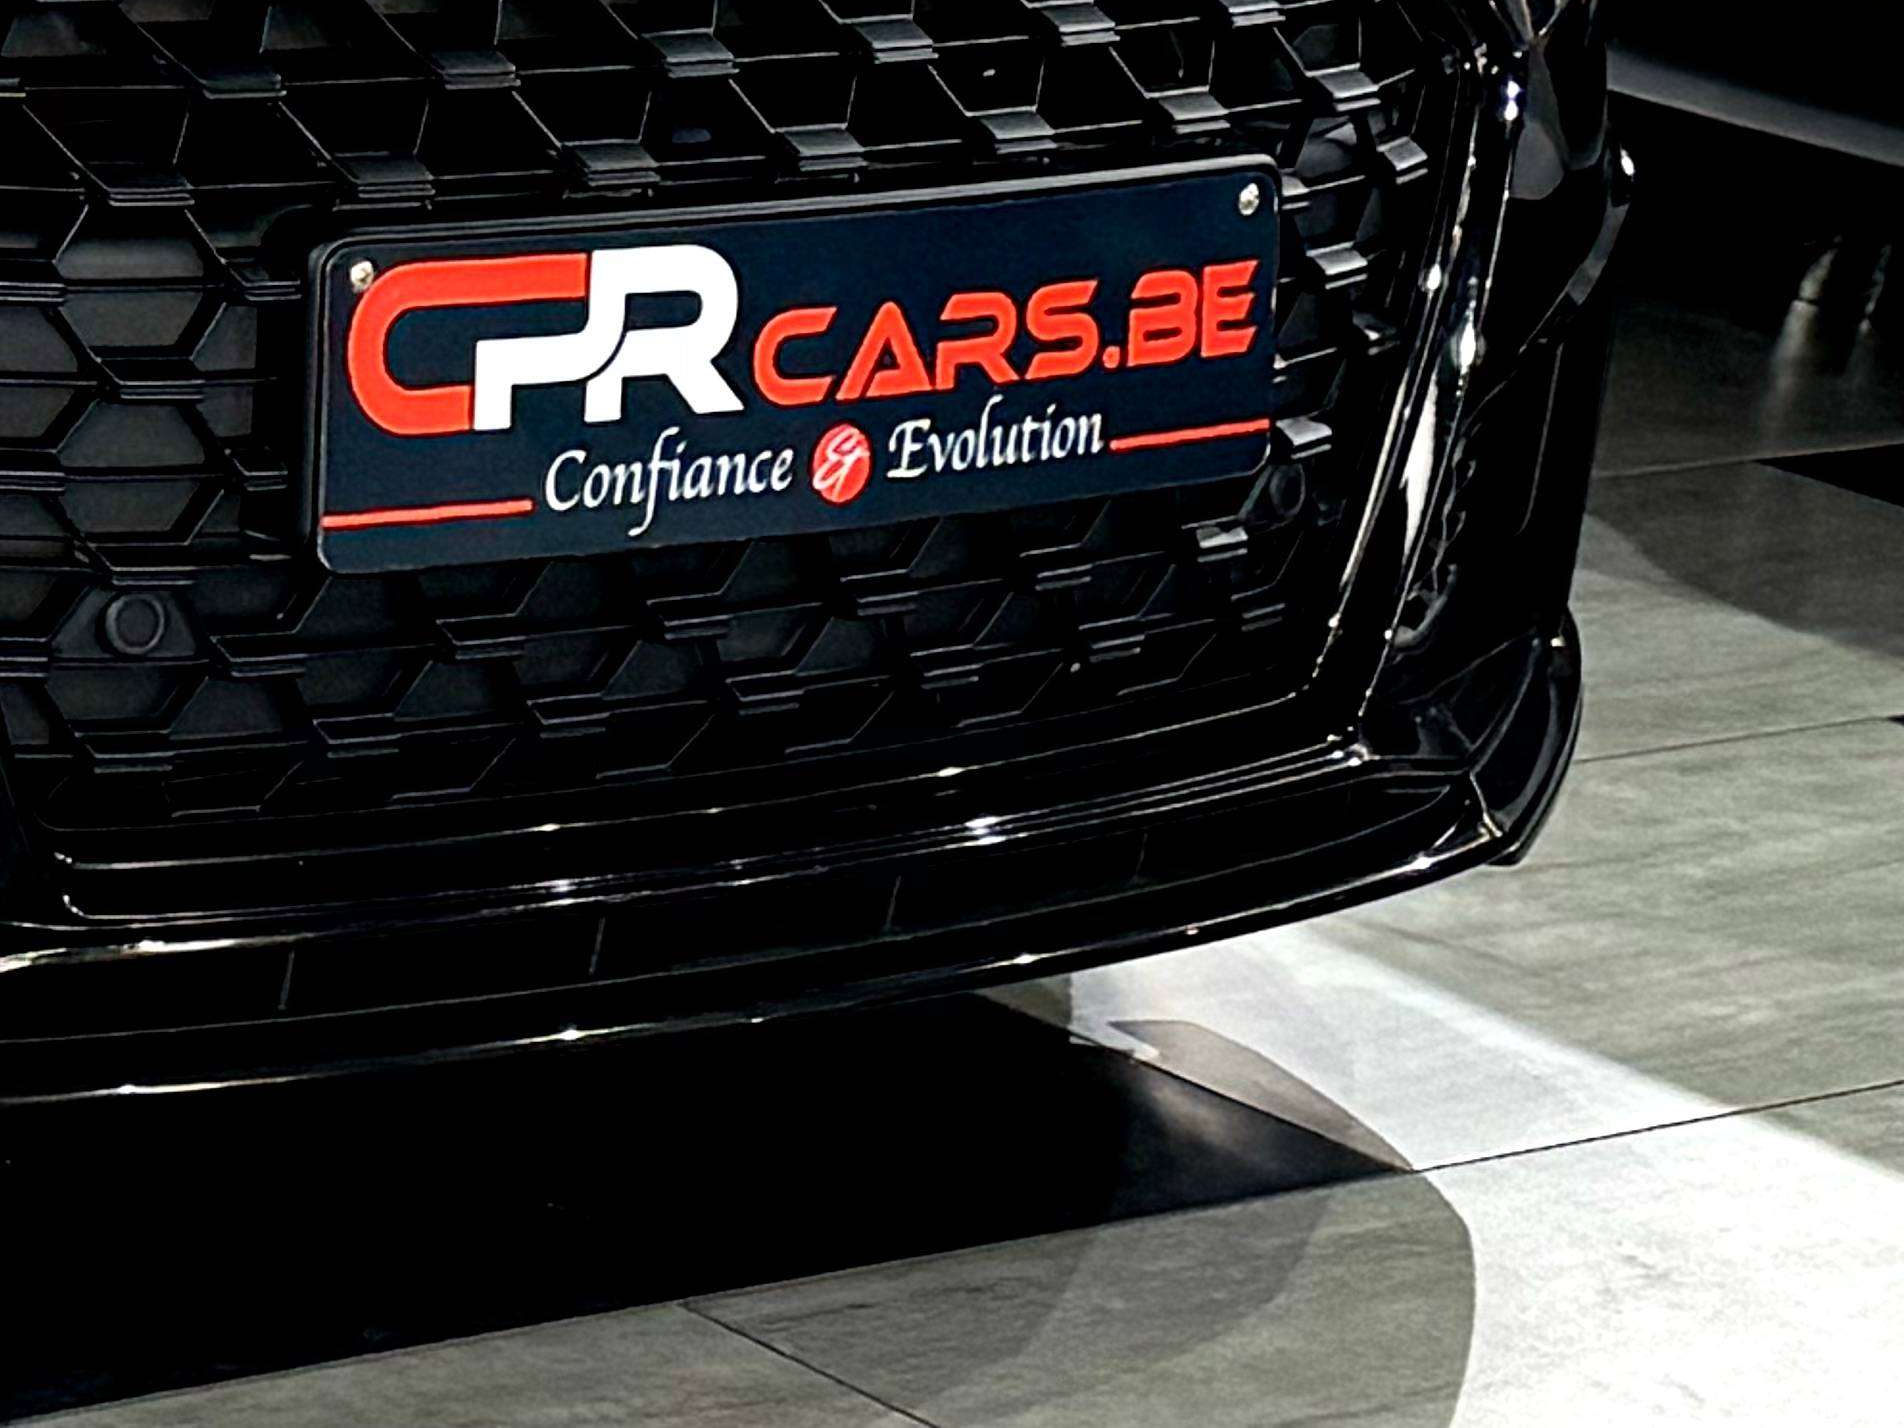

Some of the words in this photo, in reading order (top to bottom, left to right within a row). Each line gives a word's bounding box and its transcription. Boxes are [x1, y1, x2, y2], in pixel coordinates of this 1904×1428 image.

[752, 259, 1259, 407] CARS.BE
[544, 428, 794, 537] Confiance
[811, 426, 871, 504] &
[885, 394, 1105, 479] Evolution
